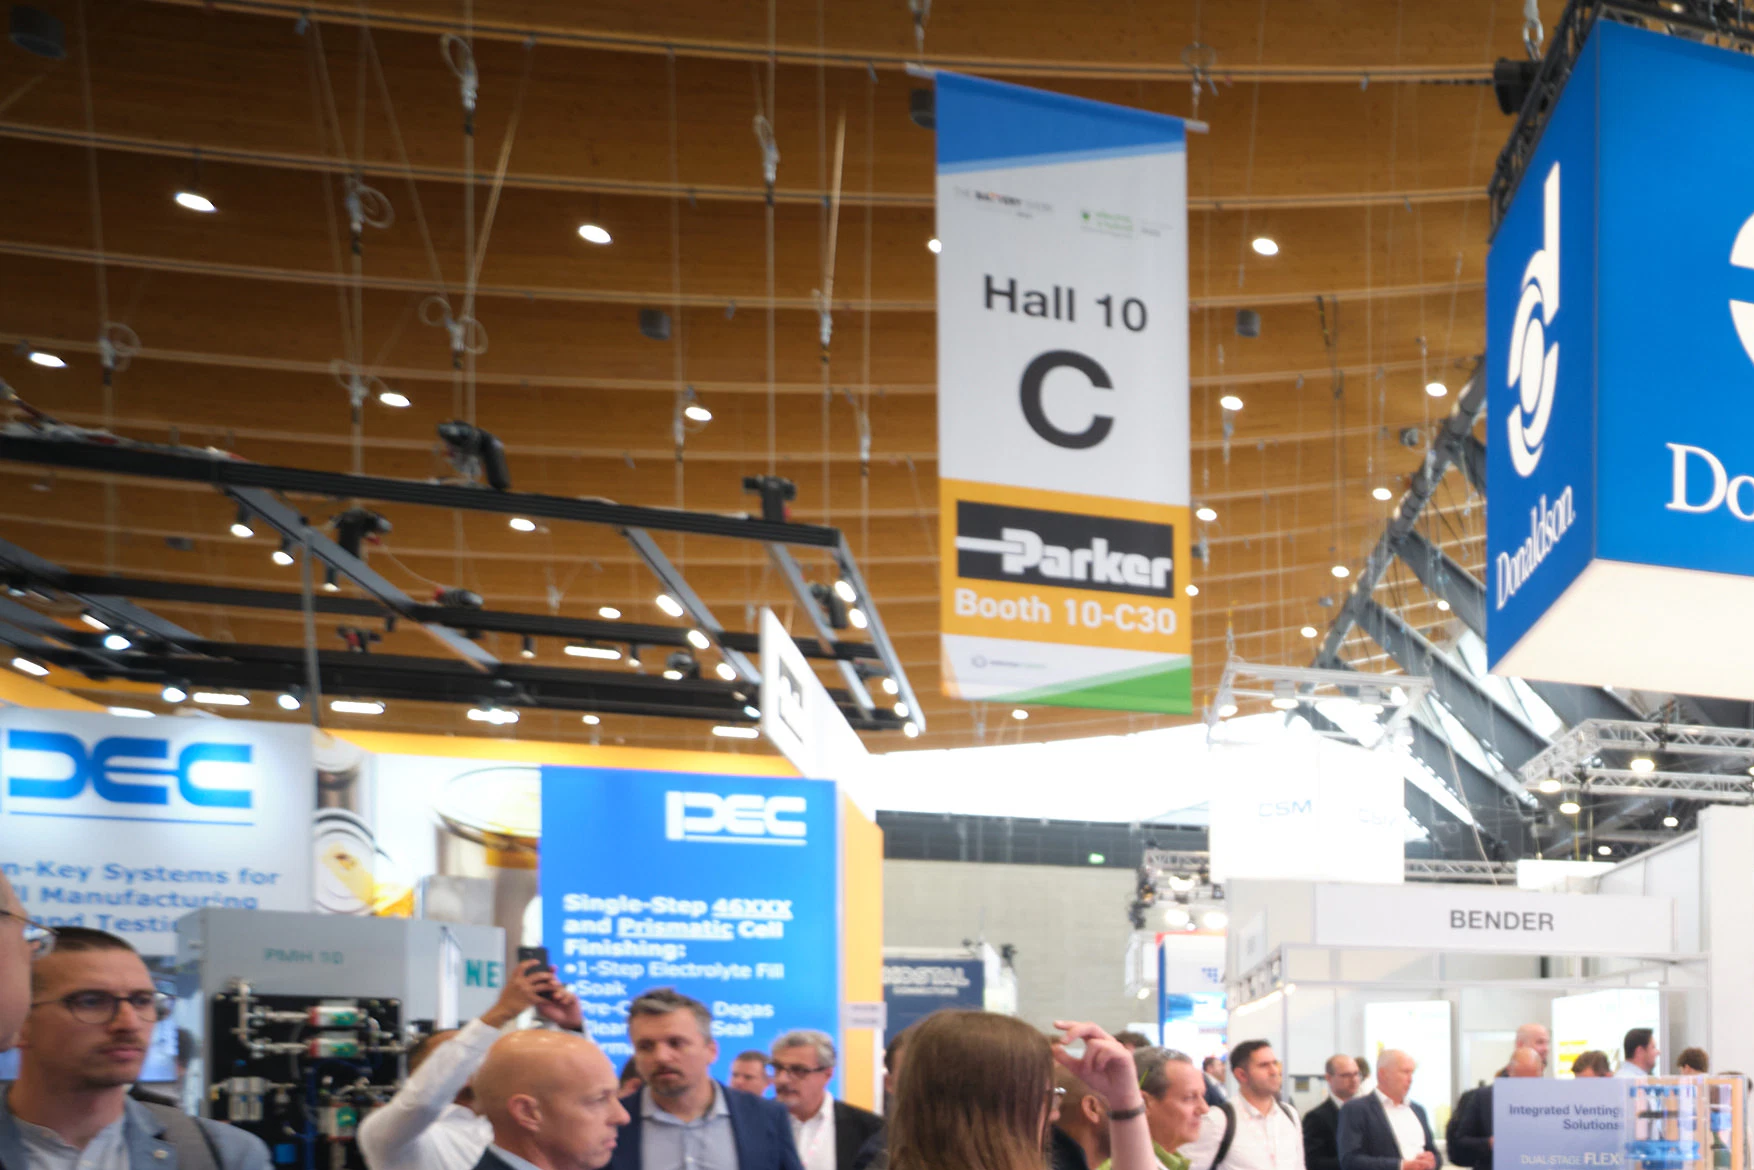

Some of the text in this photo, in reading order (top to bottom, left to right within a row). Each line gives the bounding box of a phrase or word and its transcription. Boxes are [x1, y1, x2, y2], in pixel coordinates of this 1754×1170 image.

[984, 274, 1148, 332] Hall 10
[1019, 349, 1114, 450] C
[1002, 527, 1173, 589] Parker
[954, 588, 1178, 635] Booth 10-C30
[103, 862, 229, 884] Systems
[238, 867, 282, 885] for
[40, 886, 259, 909] Manufacturing
[563, 893, 794, 919] Single-Step 46XXX
[563, 917, 784, 939] and Prismatic Cell
[1450, 909, 1554, 931] BENDER
[563, 938, 687, 961] Finishing:
[465, 958, 503, 989] NE
[648, 961, 752, 980] Electrolyte
[755, 963, 785, 979] Fill
[575, 980, 627, 996] Soak
[713, 1001, 775, 1019] Degas
[711, 1020, 754, 1037] Seal
[1509, 1104, 1622, 1118] Integrated Venting
[1563, 1119, 1621, 1130] Solutions
